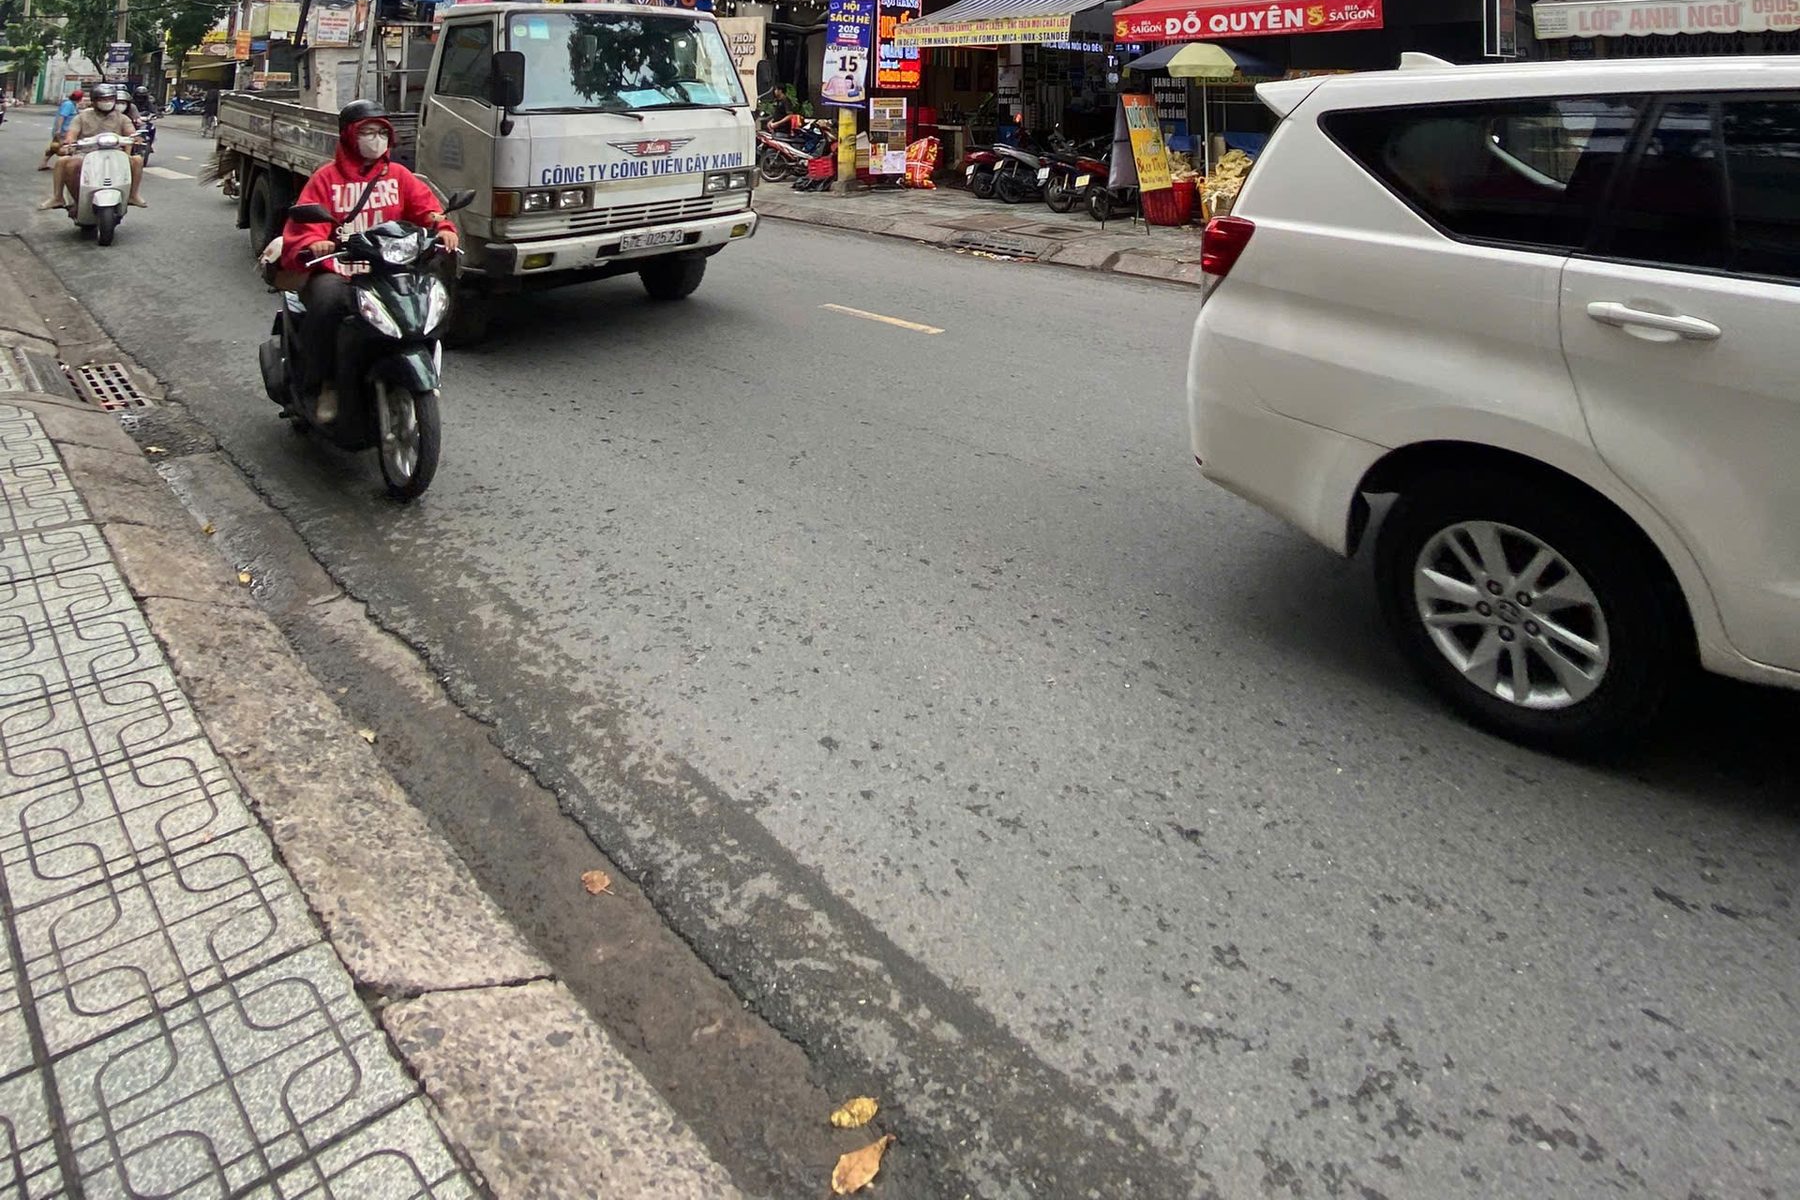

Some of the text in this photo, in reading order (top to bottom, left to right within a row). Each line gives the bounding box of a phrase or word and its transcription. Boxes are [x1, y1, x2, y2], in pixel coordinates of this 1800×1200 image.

[843, 0, 860, 13] HỘI
[830, 11, 871, 25] SÁCH HÈ
[1165, 10, 1201, 35] ĐỖ
[1209, 5, 1304, 33] QUYÊN
[1629, 6, 1681, 30] ANH
[1039, 31, 1068, 40] STANDEE
[839, 55, 858, 72] 15
[542, 152, 742, 185] CÔNG TY CÔNG VIÊN CÂY XANH
